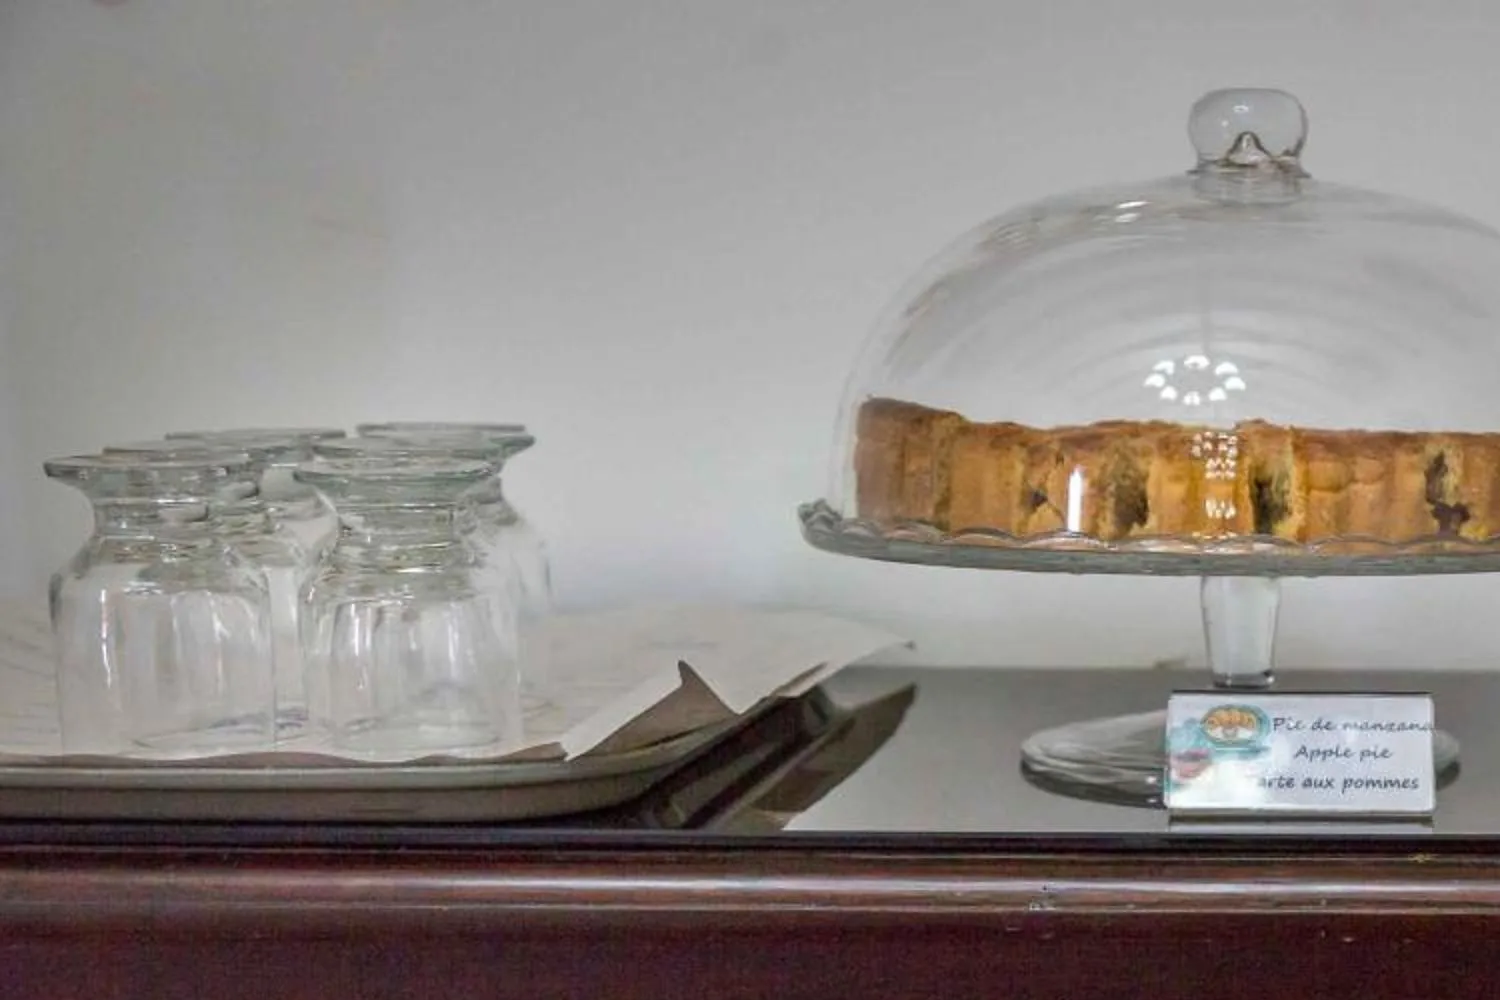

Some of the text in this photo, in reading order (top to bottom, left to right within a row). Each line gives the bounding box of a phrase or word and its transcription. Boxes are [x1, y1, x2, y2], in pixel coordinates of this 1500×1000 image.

[1311, 716, 1335, 731] de
[1294, 744, 1394, 761] Apple pie
[1257, 775, 1419, 794] arte aux pommes
